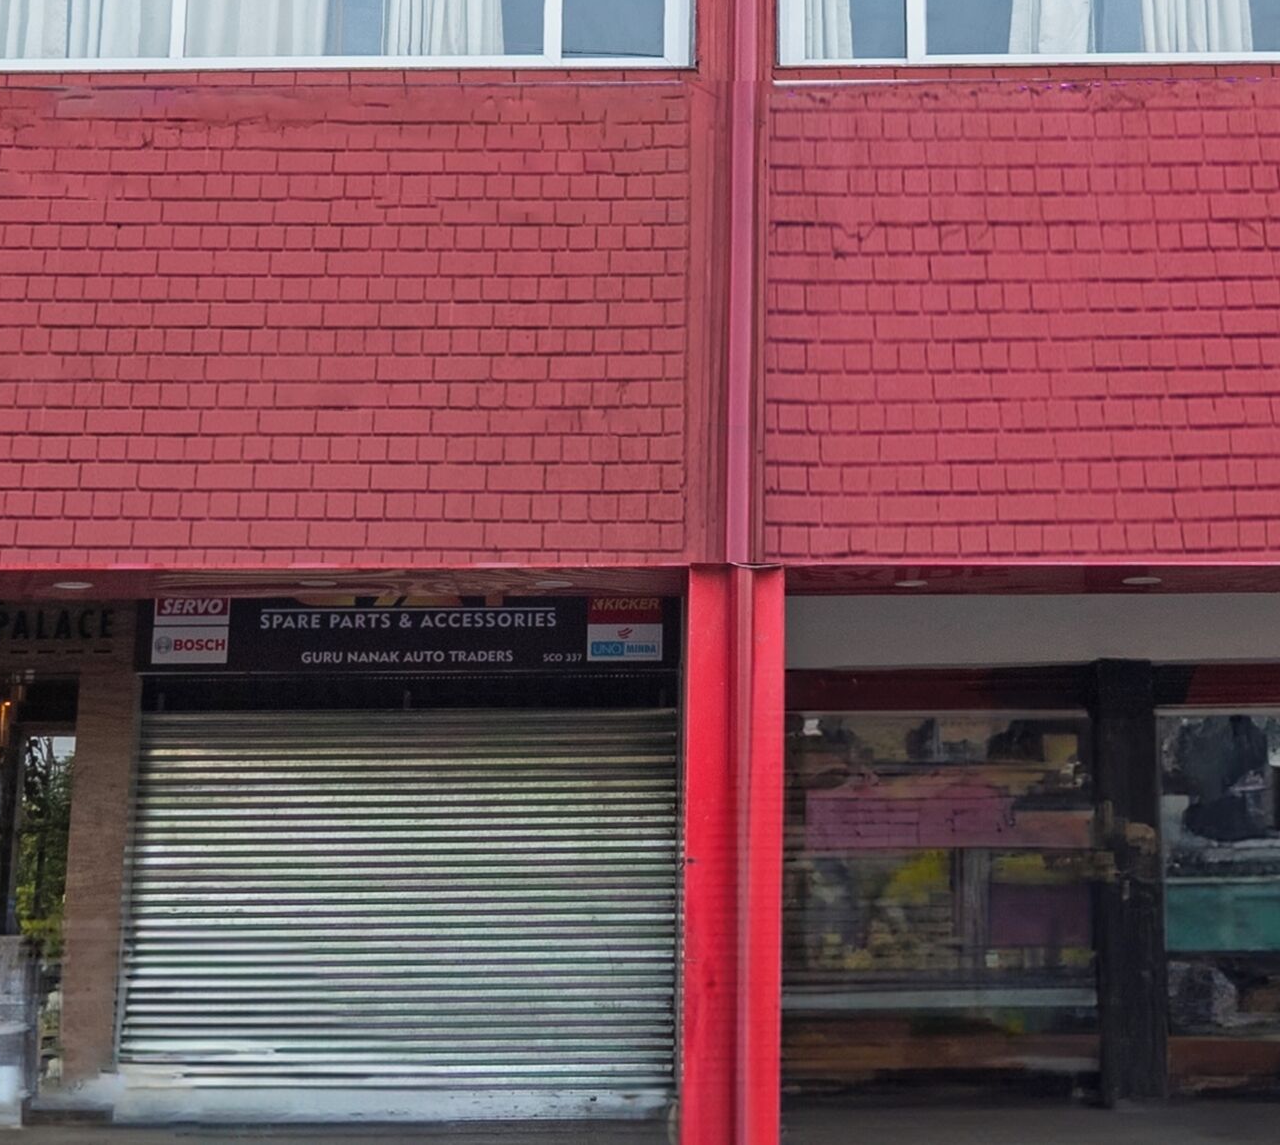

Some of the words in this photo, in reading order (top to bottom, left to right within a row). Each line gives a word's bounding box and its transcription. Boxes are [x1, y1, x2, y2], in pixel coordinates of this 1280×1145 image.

[160, 598, 224, 615] SERVO
[604, 597, 660, 610] KICKER
[260, 614, 320, 629] SPARE
[329, 613, 391, 629] PARTS
[399, 614, 412, 628] &
[420, 612, 557, 628] ACCESSORIES
[173, 639, 226, 651] BOSCH
[593, 643, 622, 655] UNO
[626, 644, 657, 654] MINDA
[301, 651, 343, 663] GURU
[347, 651, 400, 663] NANAK
[403, 650, 445, 663] AUTO
[448, 650, 514, 663] TRADERS
[543, 653, 563, 663] SCO
[565, 653, 583, 662] 337
